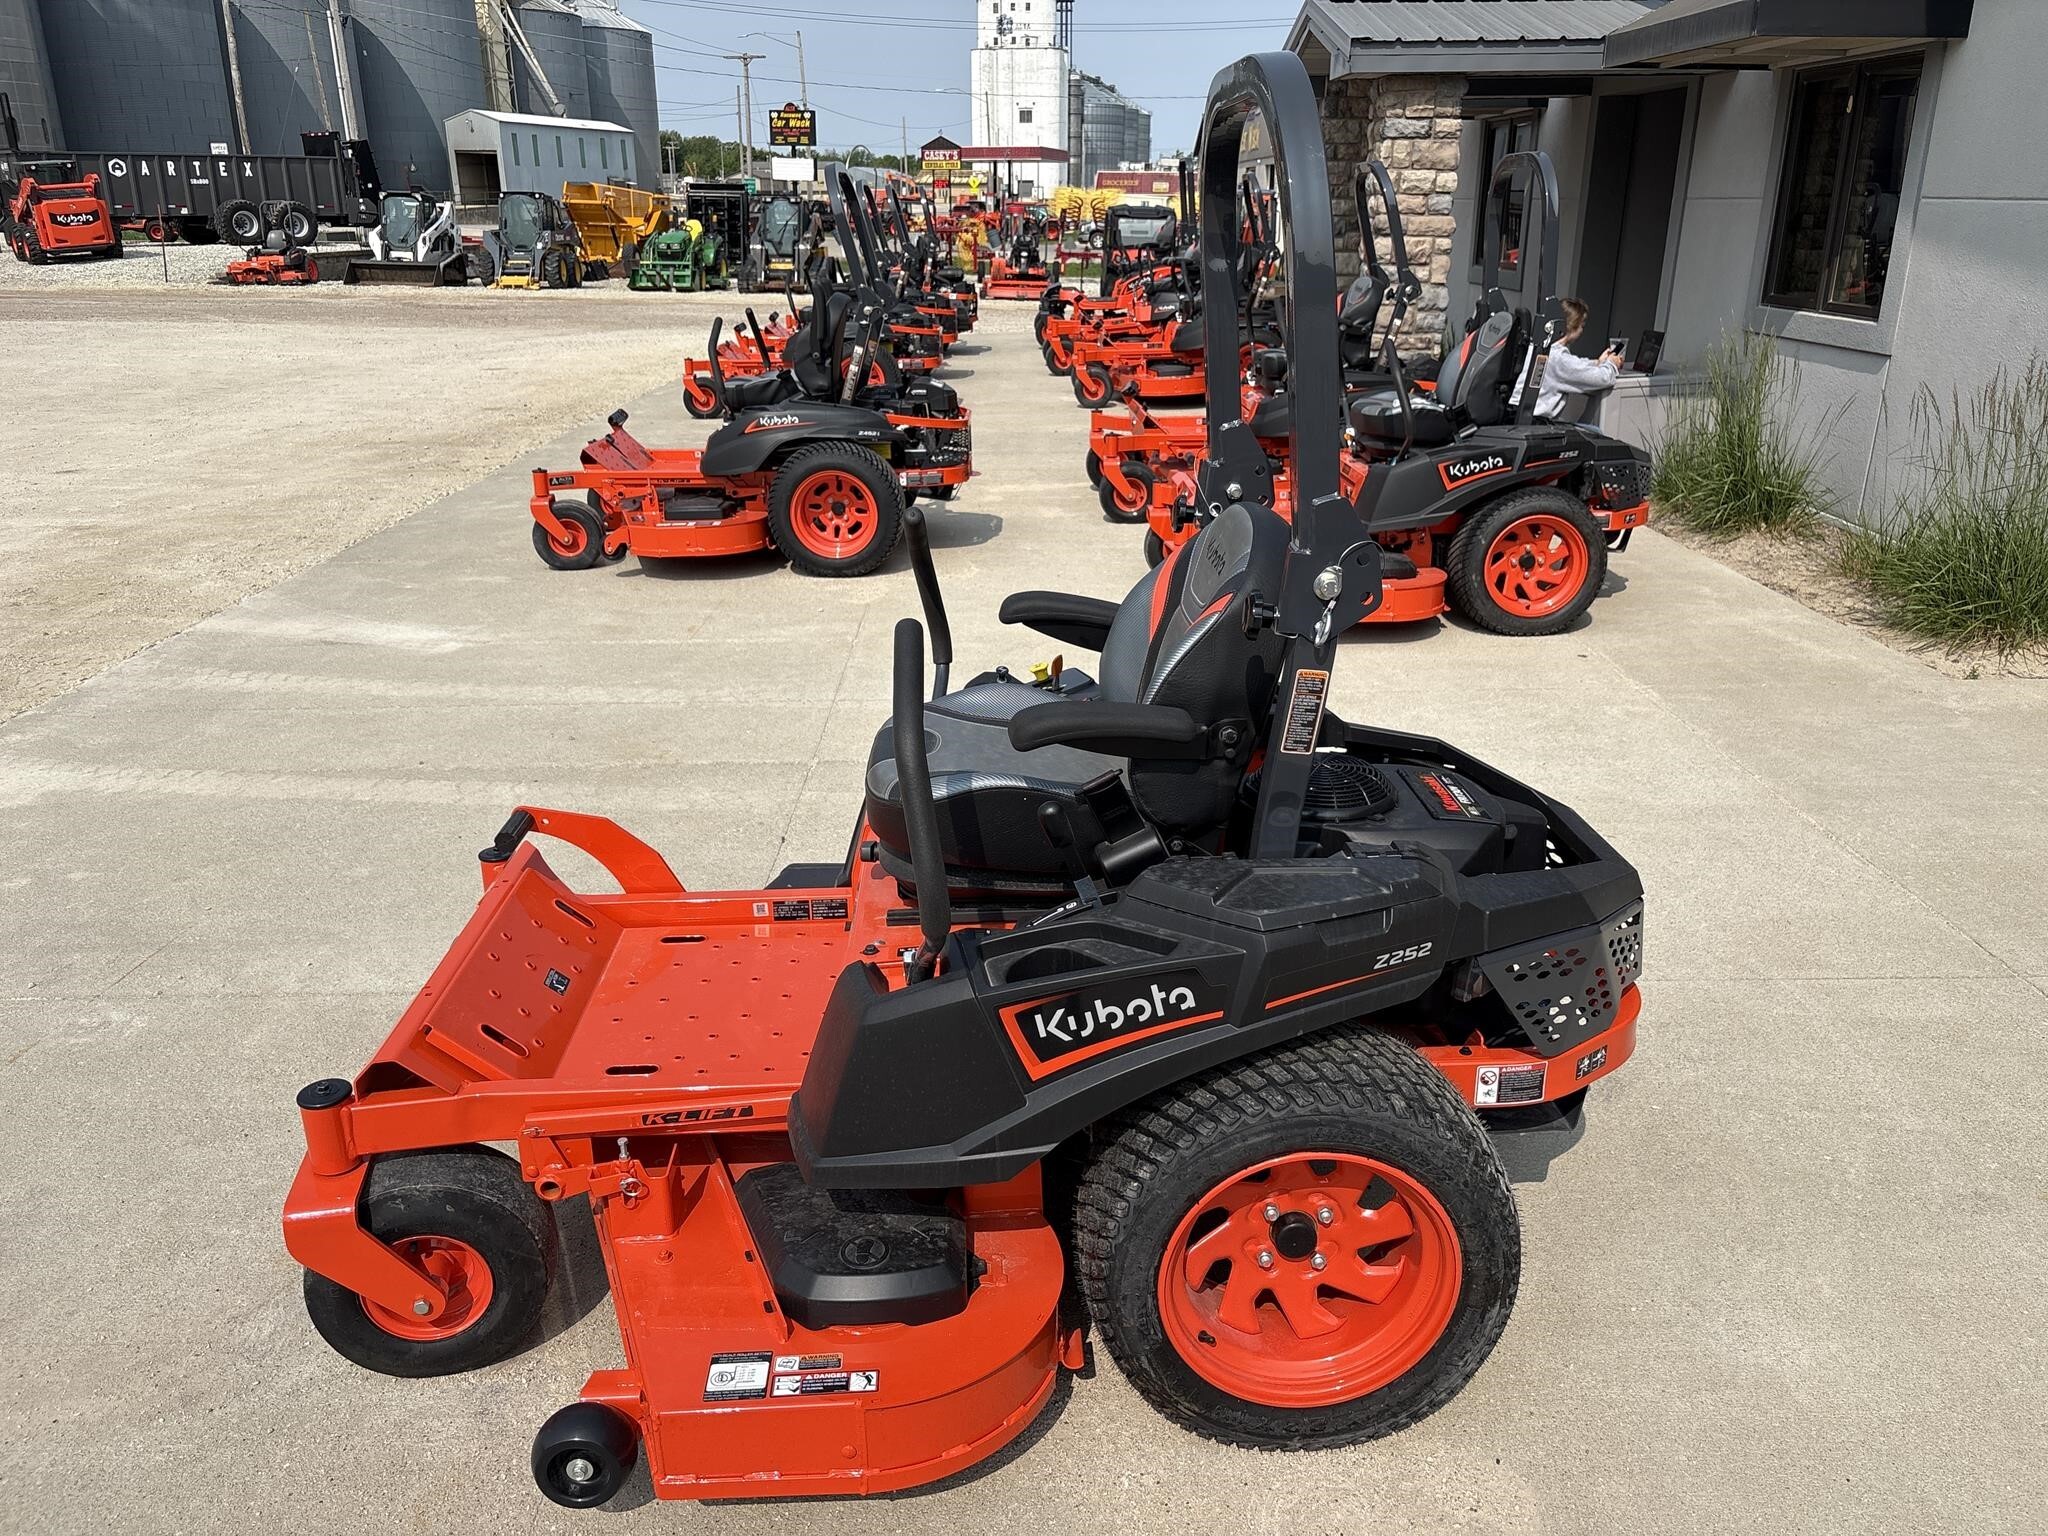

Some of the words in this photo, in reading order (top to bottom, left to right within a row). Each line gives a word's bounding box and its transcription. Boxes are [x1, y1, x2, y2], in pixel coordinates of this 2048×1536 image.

[772, 118, 786, 128] Car
[789, 118, 811, 128] Wash
[924, 150, 959, 160] CASEY'S
[141, 160, 254, 177] ARTEX
[56, 213, 94, 223] Kubota
[759, 414, 800, 426] Kubota
[1558, 450, 1579, 459] Z252
[1449, 455, 1504, 477] Kubota
[1373, 941, 1433, 970] Z252
[1034, 983, 1196, 1042] Kubota
[645, 1106, 750, 1125] K-LIFT
